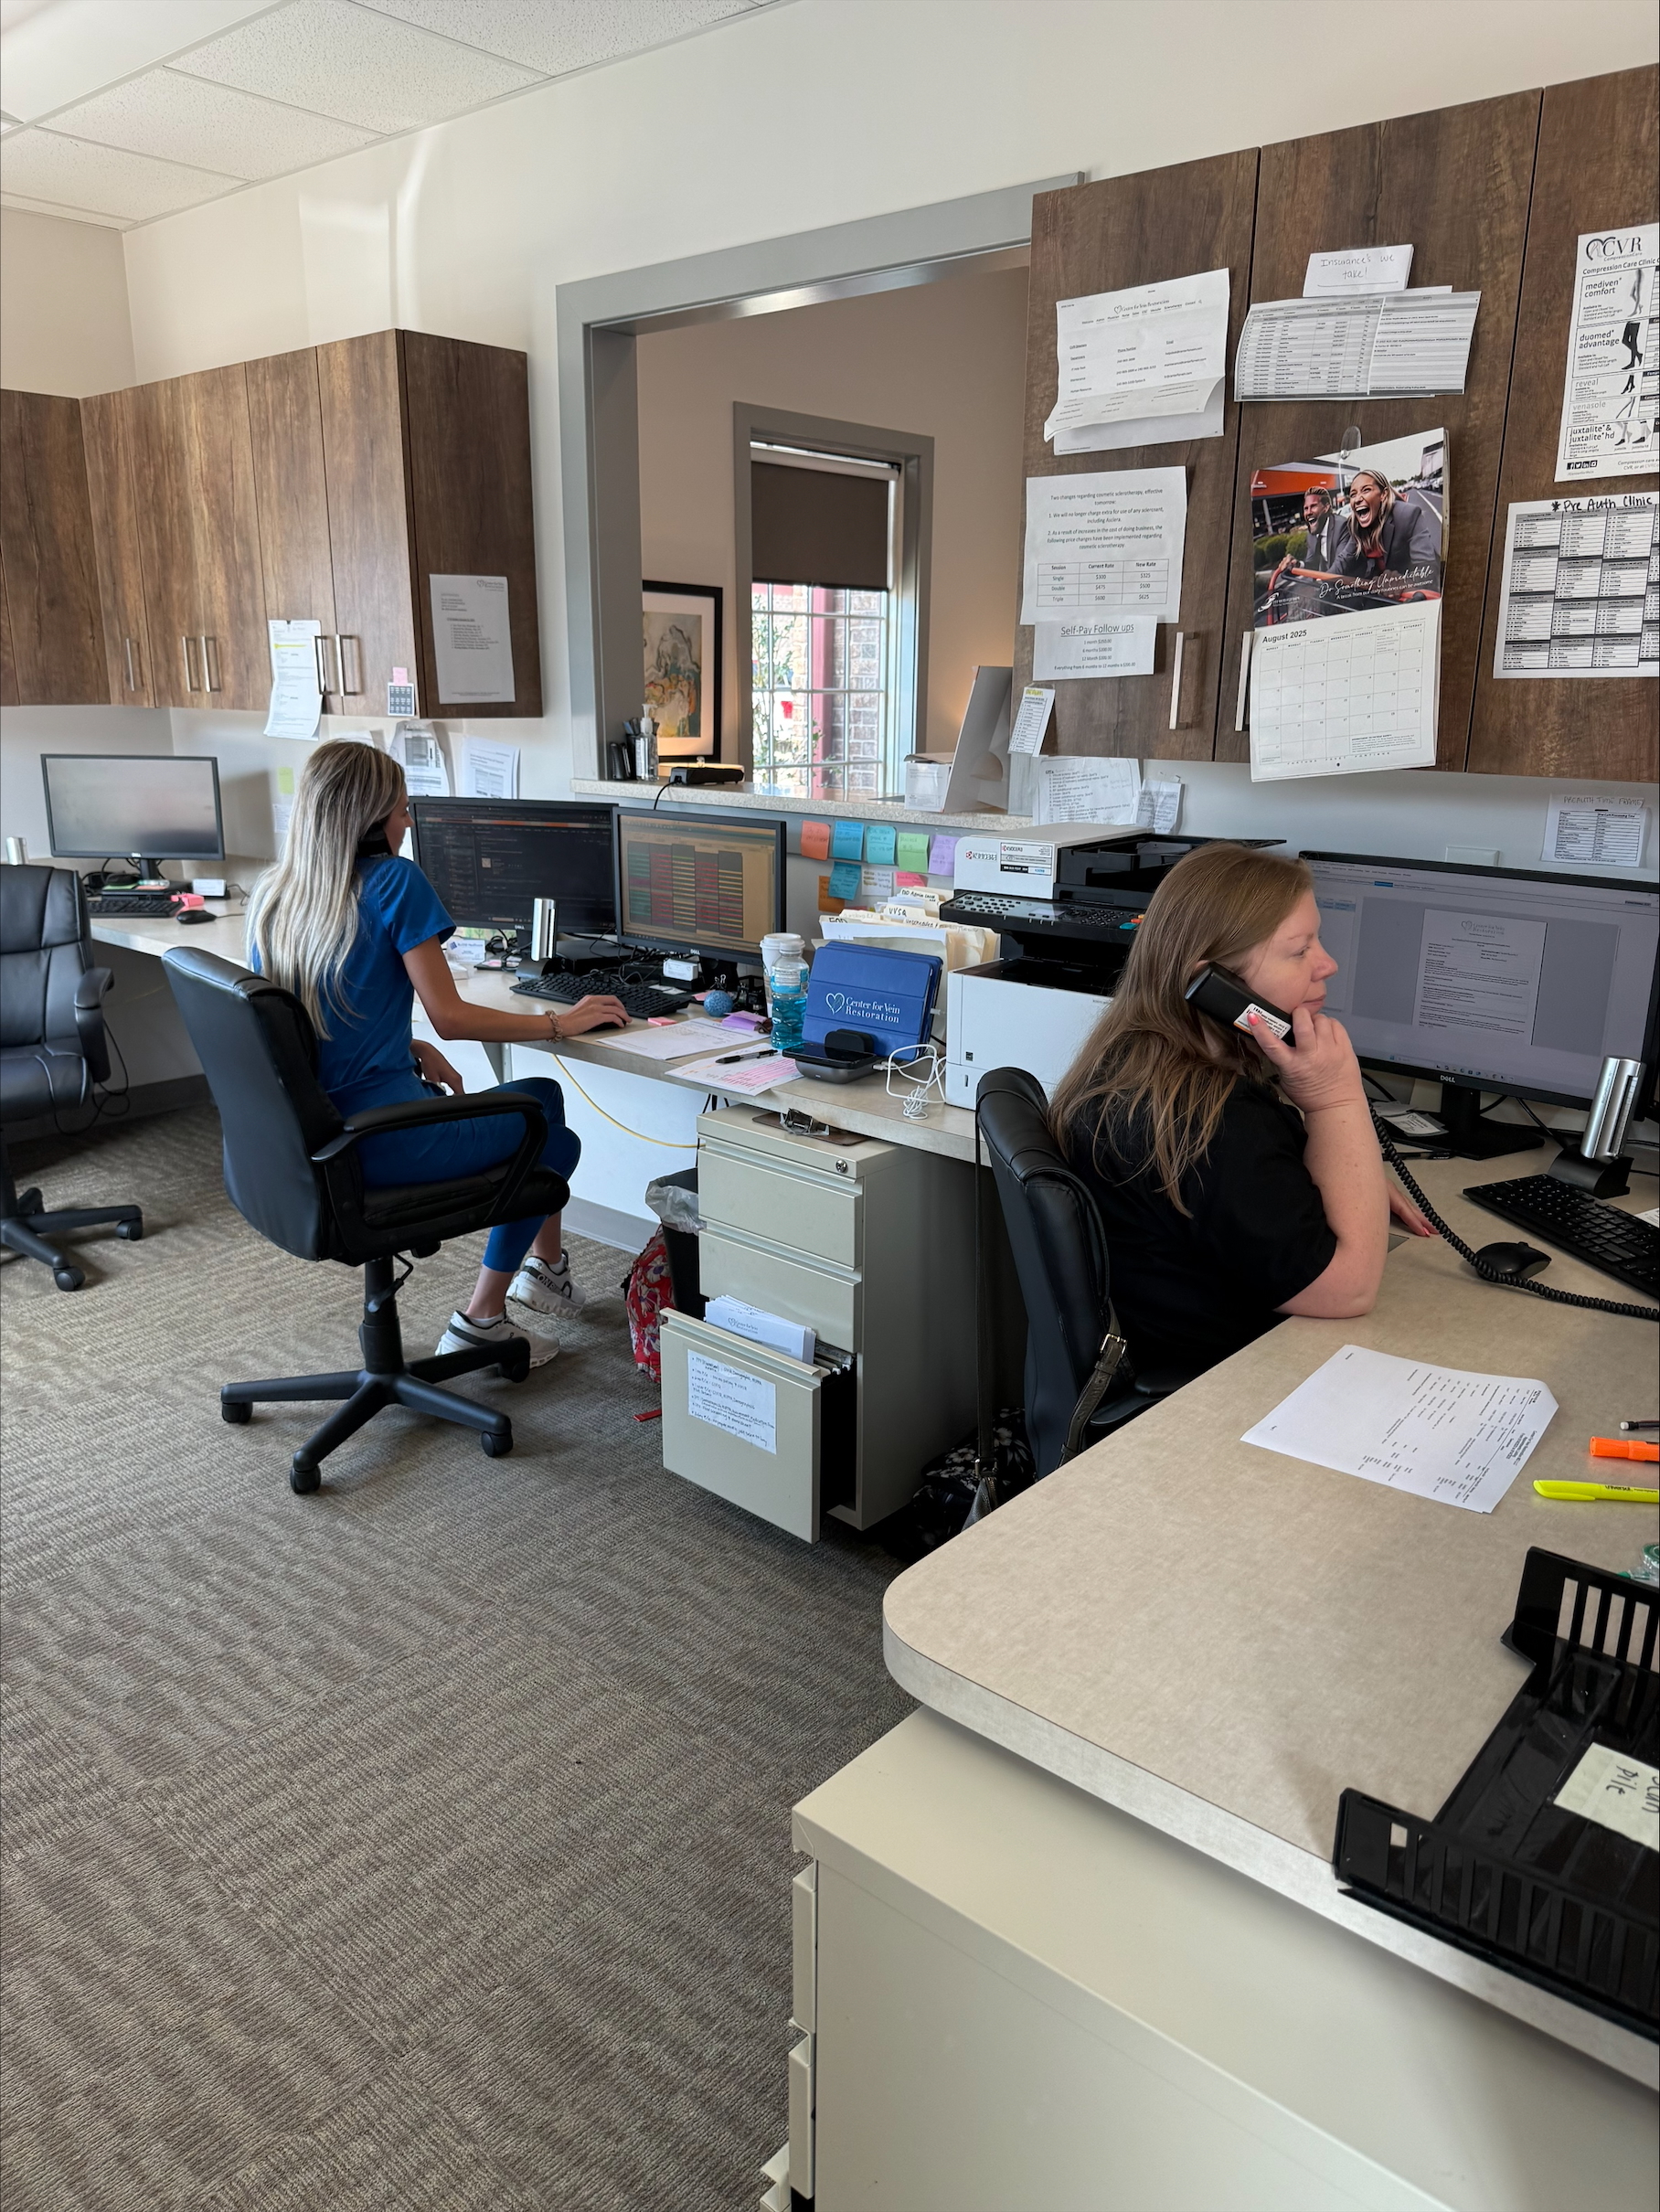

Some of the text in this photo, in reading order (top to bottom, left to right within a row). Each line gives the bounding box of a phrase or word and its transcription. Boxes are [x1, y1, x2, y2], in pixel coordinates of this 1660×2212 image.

[1602, 237, 1643, 257] CVR
[1321, 254, 1371, 267] Insurance's
[1582, 263, 1622, 274] Compression
[1639, 258, 1655, 266] Clinic
[1585, 287, 1615, 297] comfort
[1580, 338, 1620, 349] advantage
[1576, 378, 1599, 387] reveal
[1573, 401, 1606, 410] venasole
[1564, 495, 1653, 512] Pre Auth Clinic
[1319, 566, 1433, 598] Do Something Unpredictable
[1060, 623, 1133, 635] Self-Pay Follow ups
[1262, 630, 1307, 643] August 2025
[846, 996, 900, 1015] Center for Vein
[846, 1006, 899, 1023] Restoration
[1440, 1075, 1455, 1083] DELL
